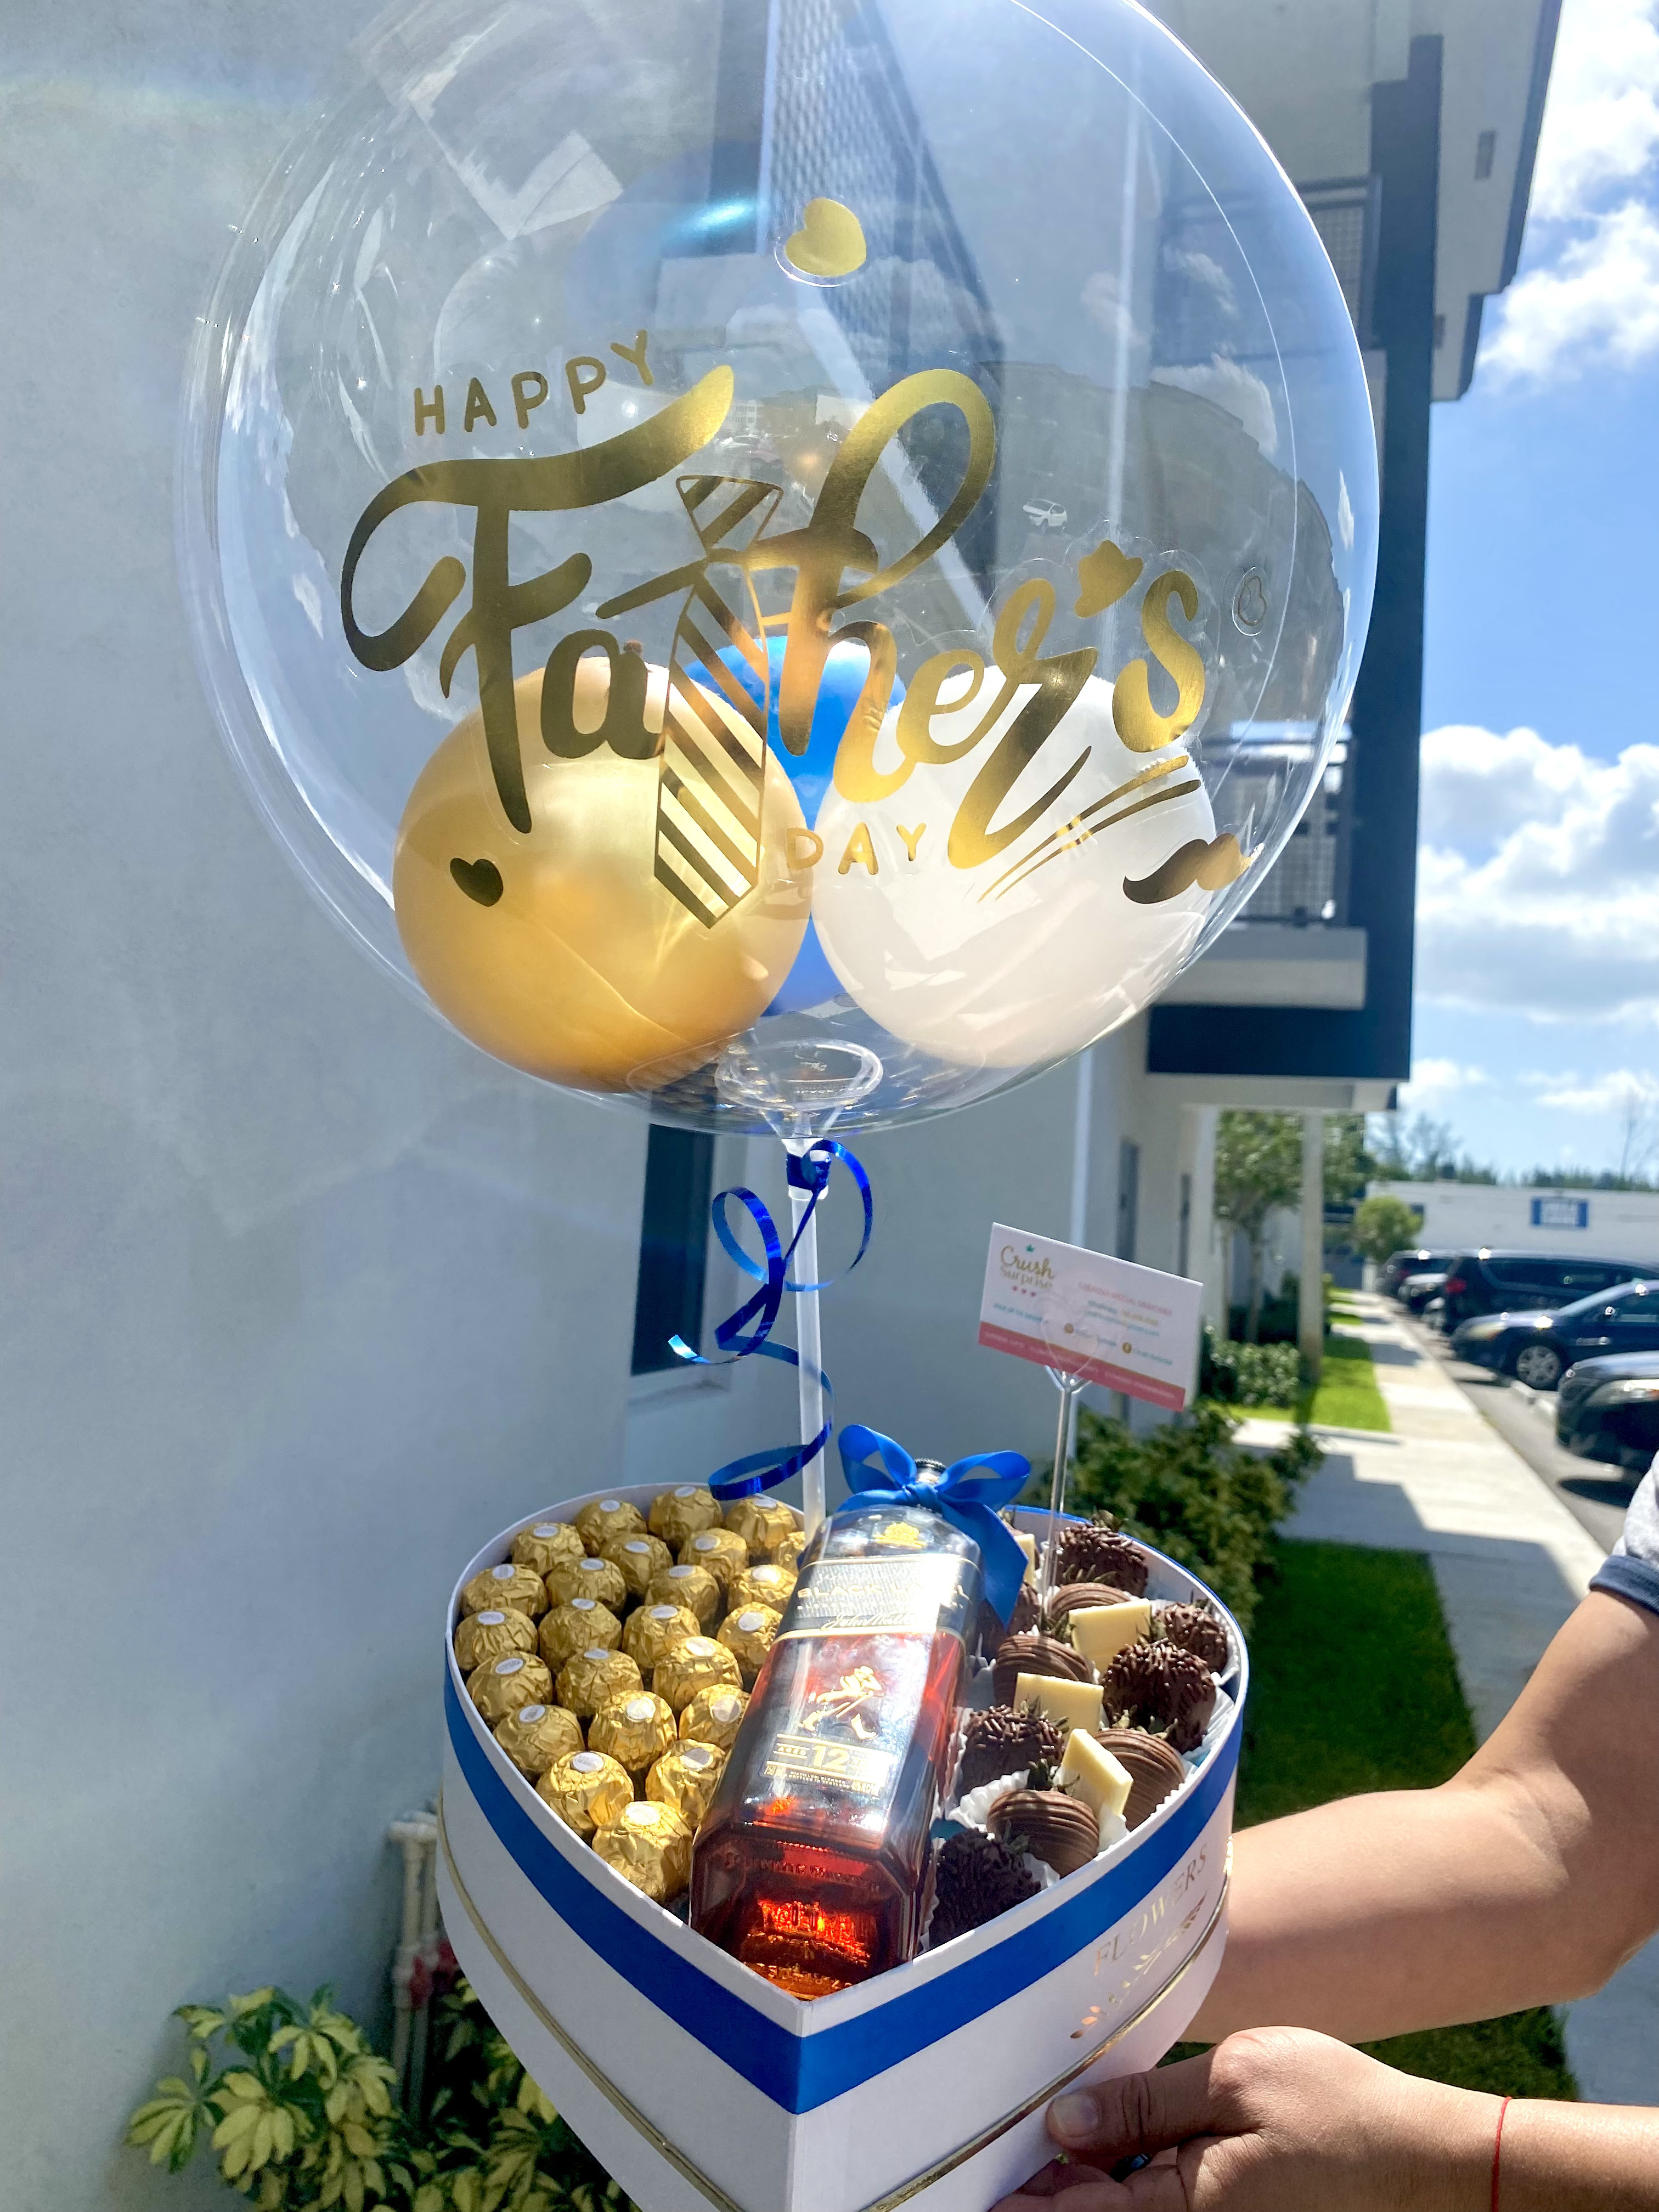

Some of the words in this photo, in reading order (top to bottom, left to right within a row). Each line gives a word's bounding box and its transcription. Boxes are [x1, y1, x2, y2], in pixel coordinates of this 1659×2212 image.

[414, 330, 654, 436] HAPPY
[341, 365, 1205, 928] Father's
[786, 822, 927, 875] DAY
[1000, 1245, 1056, 1280] Crush
[797, 1584, 883, 1598] BLACK
[811, 1745, 850, 1771] 12
[1094, 1844, 1207, 1976] FLOWERS
